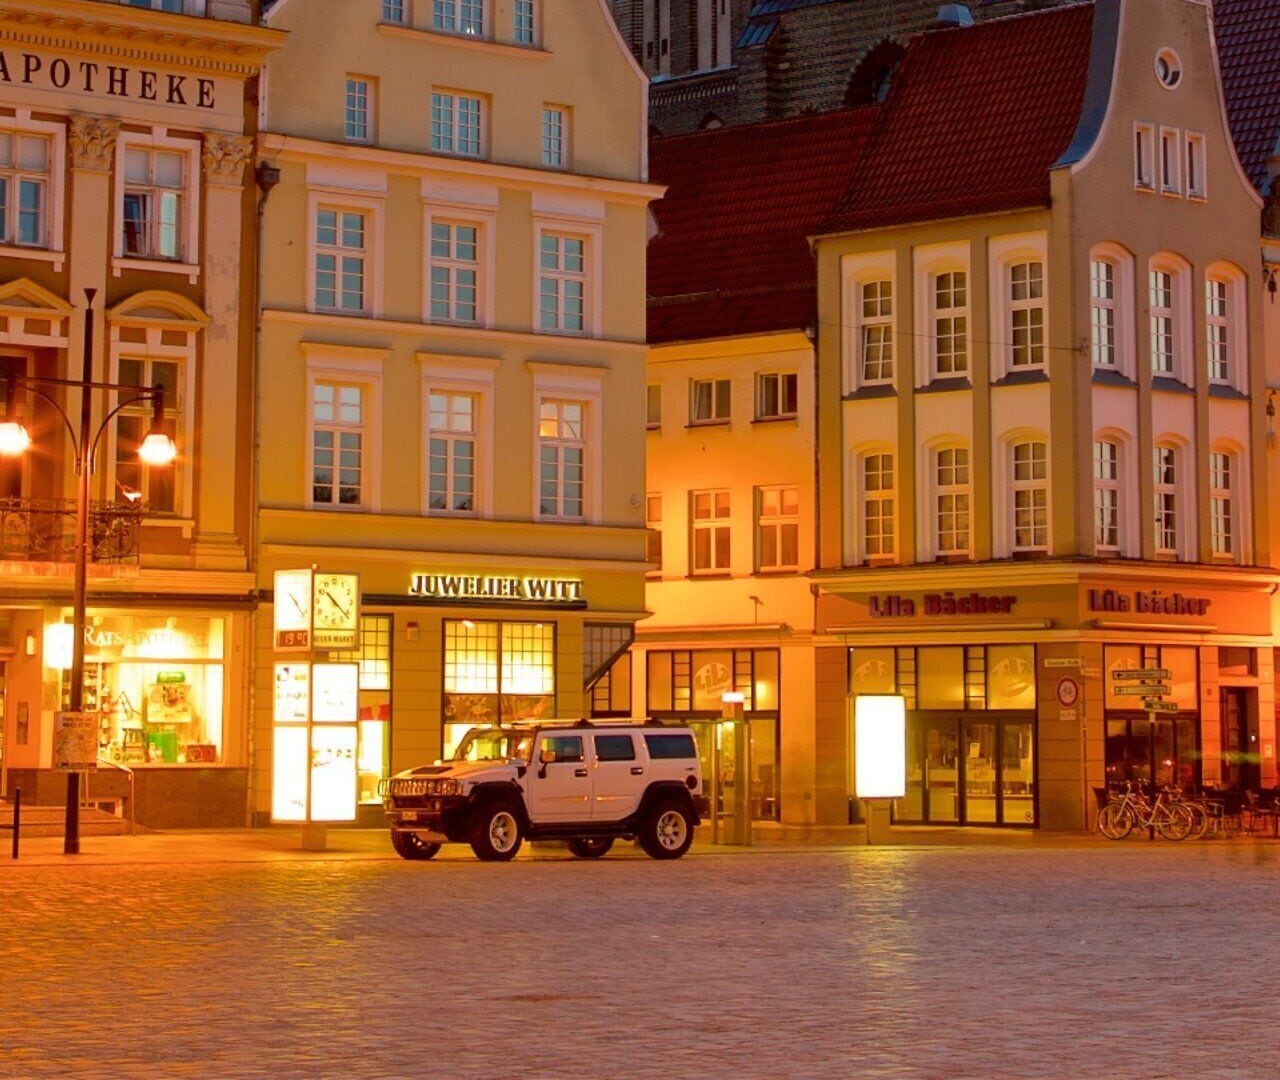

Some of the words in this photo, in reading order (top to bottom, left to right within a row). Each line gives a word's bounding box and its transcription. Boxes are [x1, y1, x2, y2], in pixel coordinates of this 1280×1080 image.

[409, 575, 522, 597] JUWELIER
[526, 579, 584, 600] WITT
[870, 595, 915, 618] Lila
[924, 592, 1017, 616] Bäcker
[1089, 588, 1131, 612] Lila
[1135, 589, 1212, 616] Bäcker
